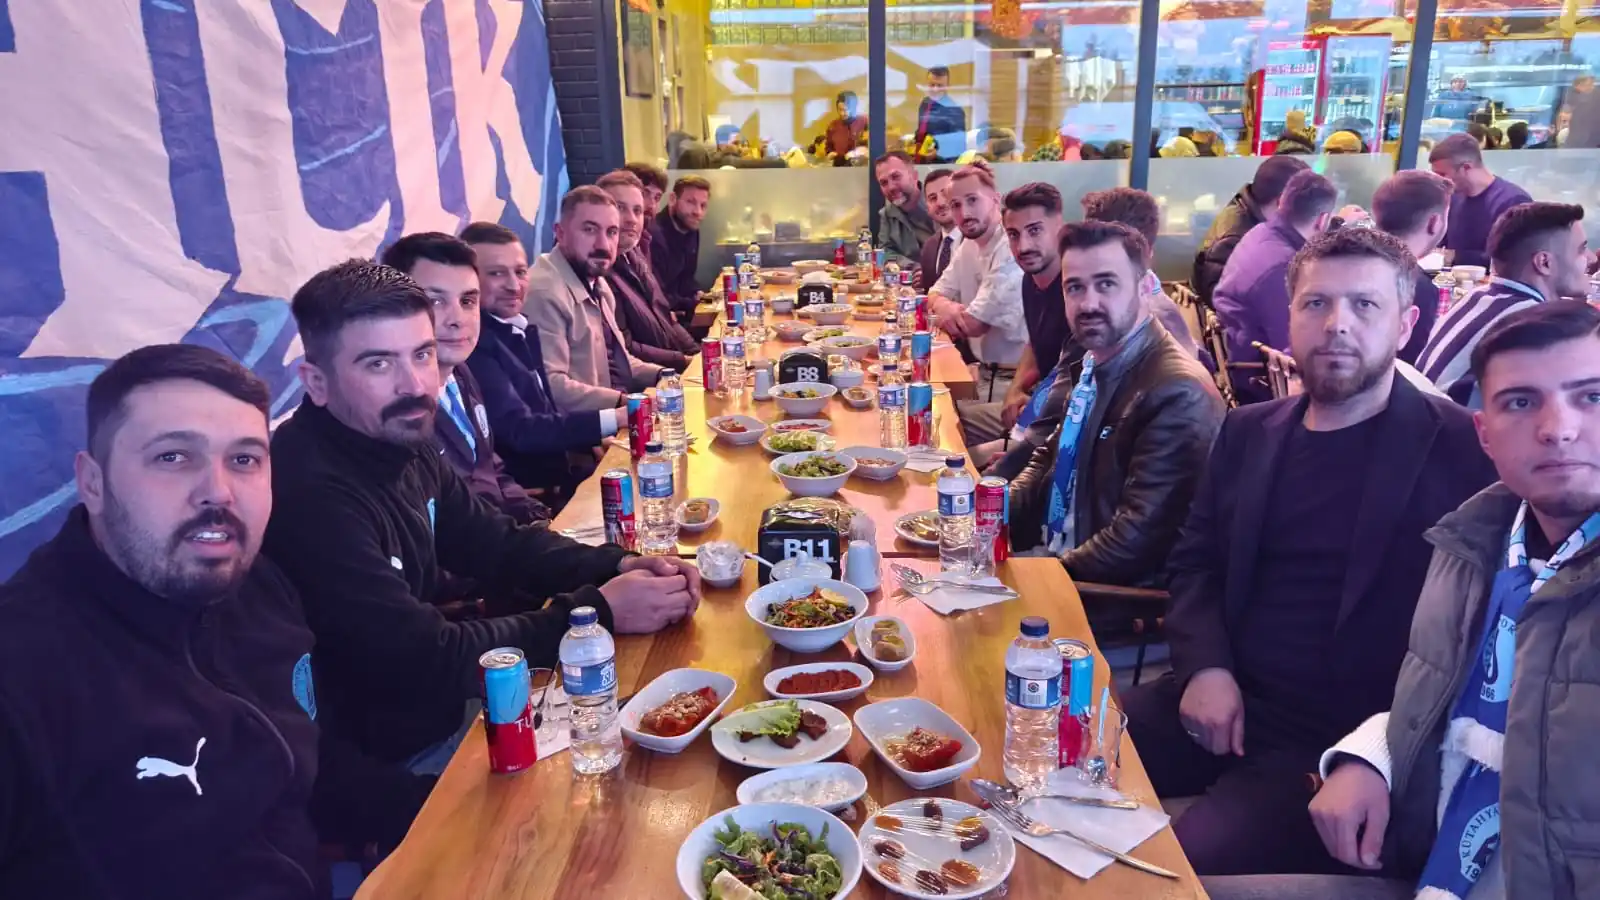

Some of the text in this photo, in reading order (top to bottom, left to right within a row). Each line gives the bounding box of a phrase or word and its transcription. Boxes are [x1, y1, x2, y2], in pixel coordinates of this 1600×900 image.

[809, 291, 826, 303] B4
[797, 366, 819, 382] B8
[783, 538, 834, 562] B11
